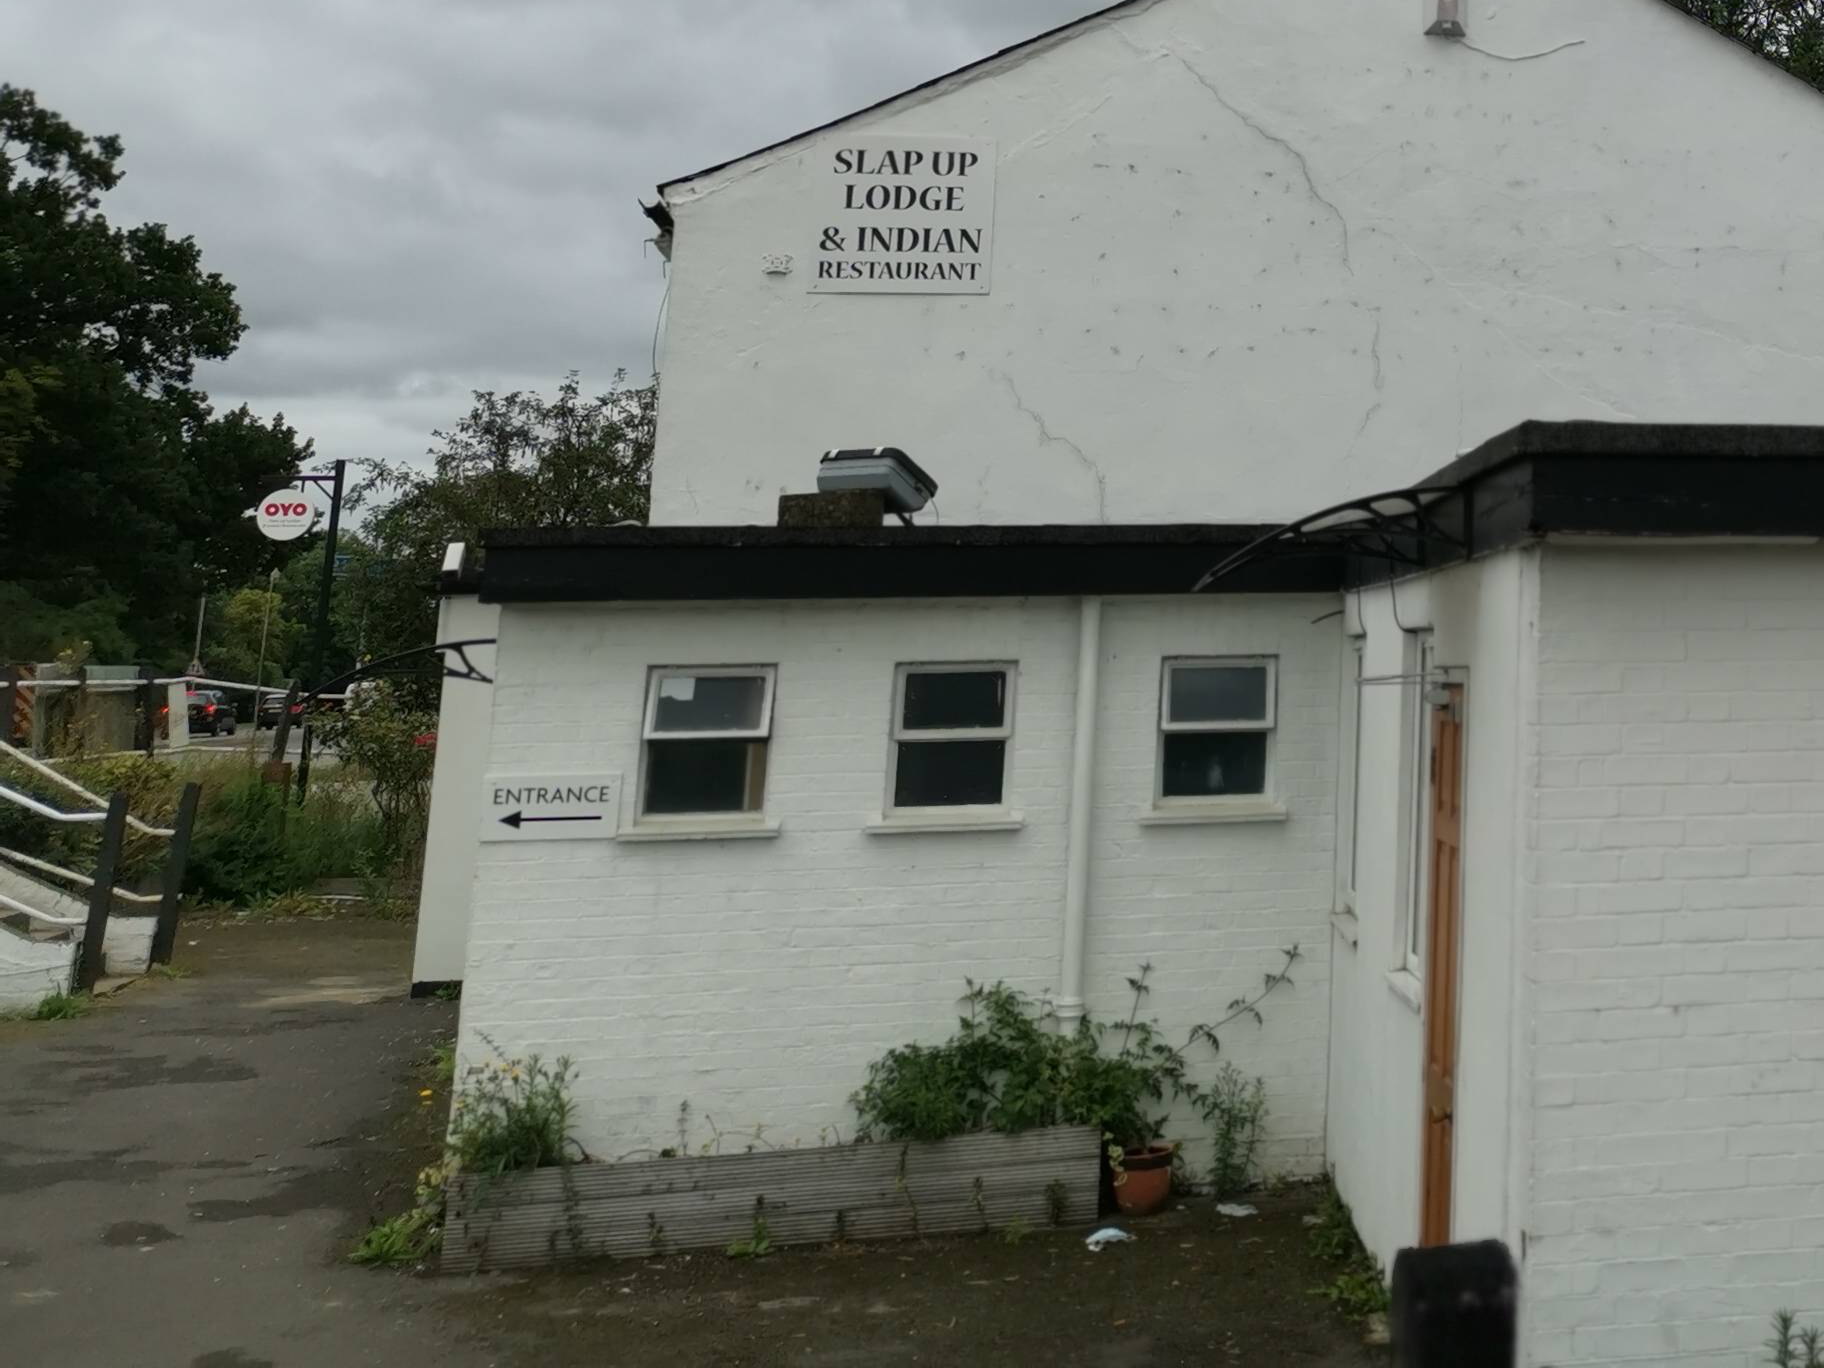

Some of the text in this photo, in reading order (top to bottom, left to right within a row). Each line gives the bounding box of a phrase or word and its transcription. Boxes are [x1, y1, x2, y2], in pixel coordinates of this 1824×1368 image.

[833, 148, 979, 177] SLAP UP
[843, 184, 966, 212] LODGE
[818, 226, 983, 253] & INDIAN
[817, 260, 982, 281] RESTAURANT
[265, 503, 307, 516] OYO
[493, 786, 610, 805] ENTRANCE
